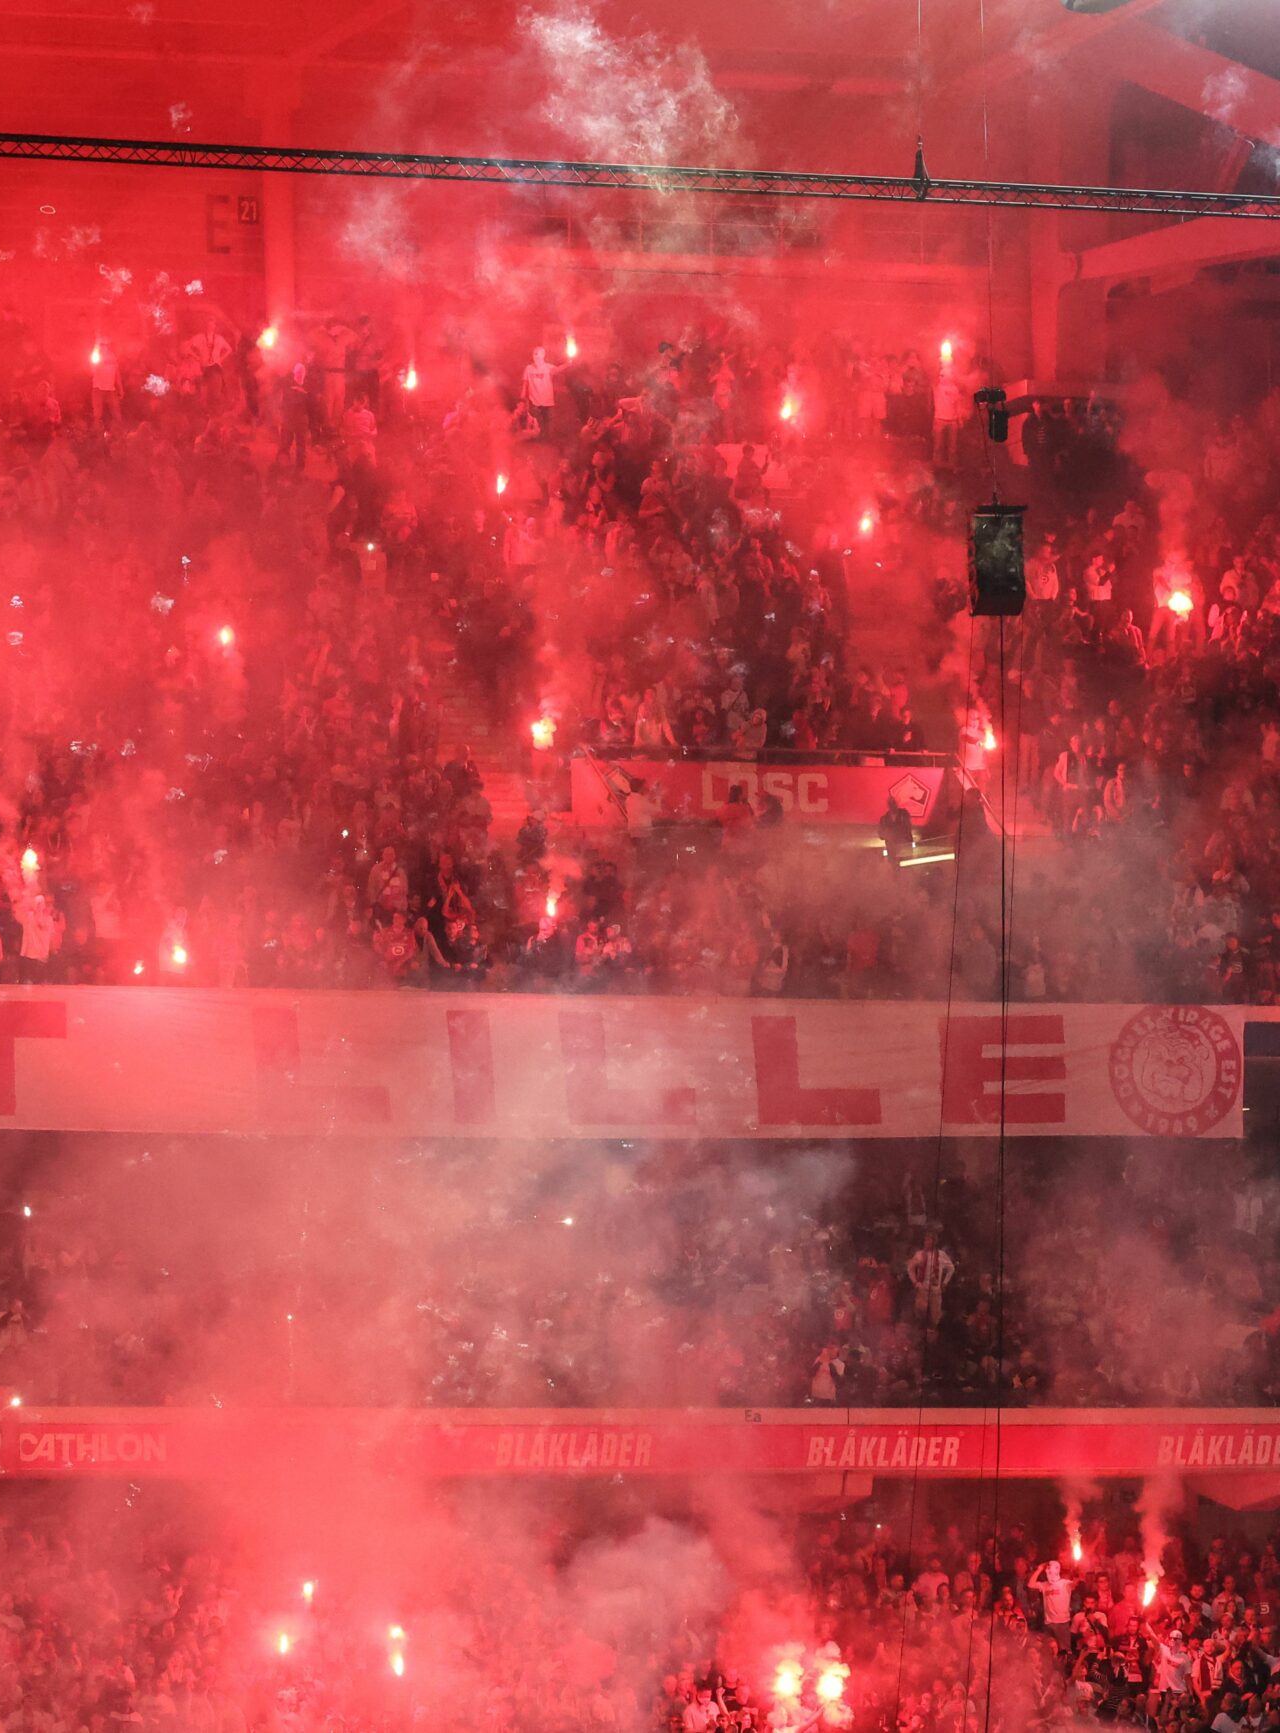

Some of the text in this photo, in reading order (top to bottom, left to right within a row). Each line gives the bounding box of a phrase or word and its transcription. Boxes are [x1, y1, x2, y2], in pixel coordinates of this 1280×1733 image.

[207, 193, 257, 254] E 21
[251, 1006, 1067, 1126] LILLE
[807, 1429, 960, 1467] BLÅKLÄDER
